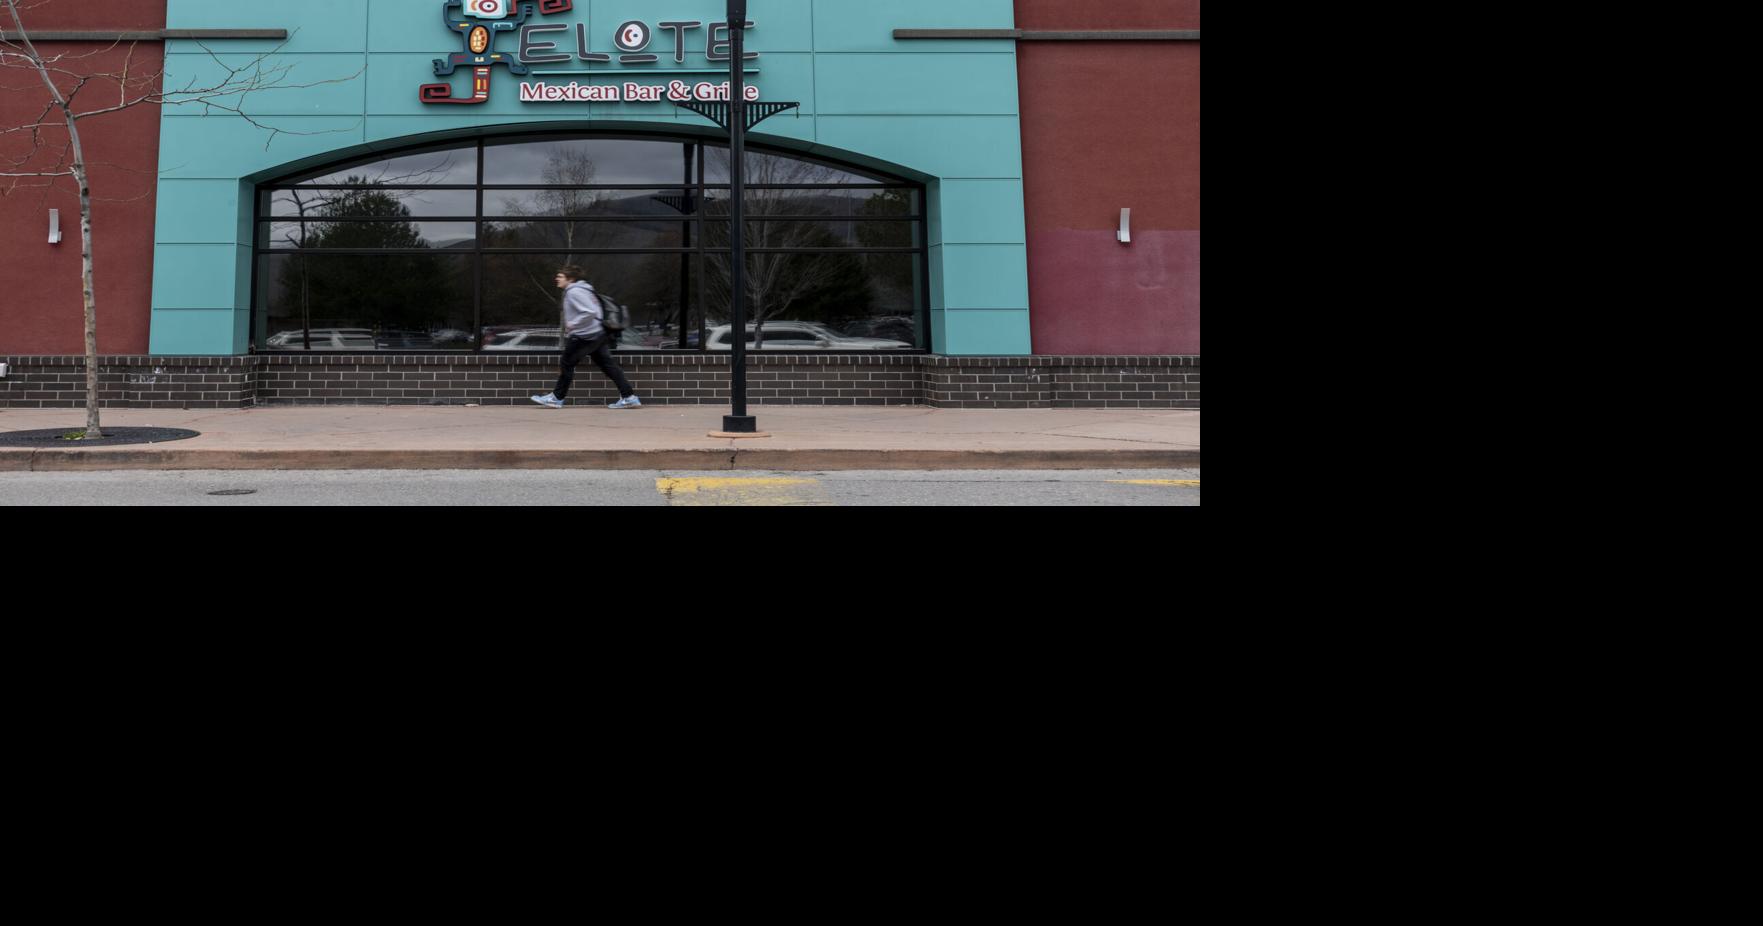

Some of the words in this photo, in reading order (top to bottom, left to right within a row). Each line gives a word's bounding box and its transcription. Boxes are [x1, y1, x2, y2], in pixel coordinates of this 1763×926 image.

[518, 20, 760, 63] ELOTE
[520, 82, 620, 101] Mexican
[623, 82, 665, 101] Bar
[667, 80, 691, 101] &
[693, 81, 759, 101] Grie
